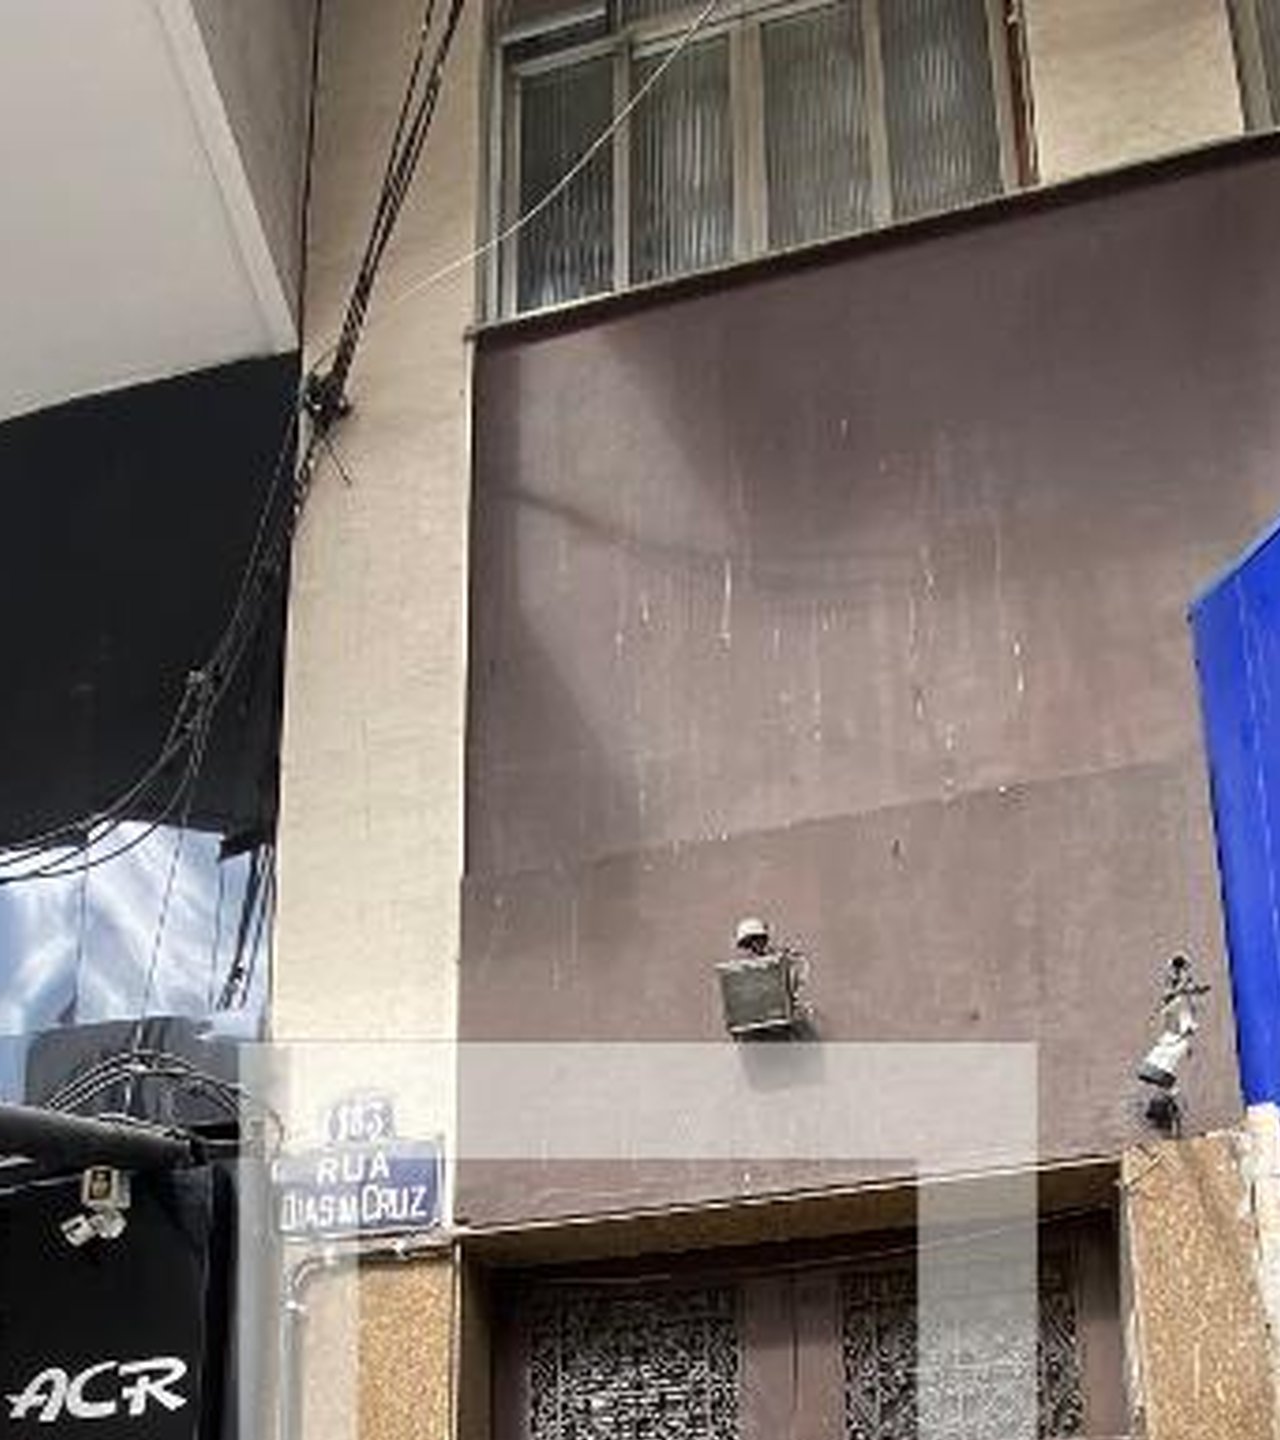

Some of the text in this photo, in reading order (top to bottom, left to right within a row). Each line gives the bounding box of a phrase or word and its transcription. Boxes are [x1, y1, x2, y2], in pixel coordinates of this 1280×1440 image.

[316, 1150, 390, 1184] RUA
[361, 1184, 427, 1221] CRUZ
[4, 1357, 188, 1422] ACR
